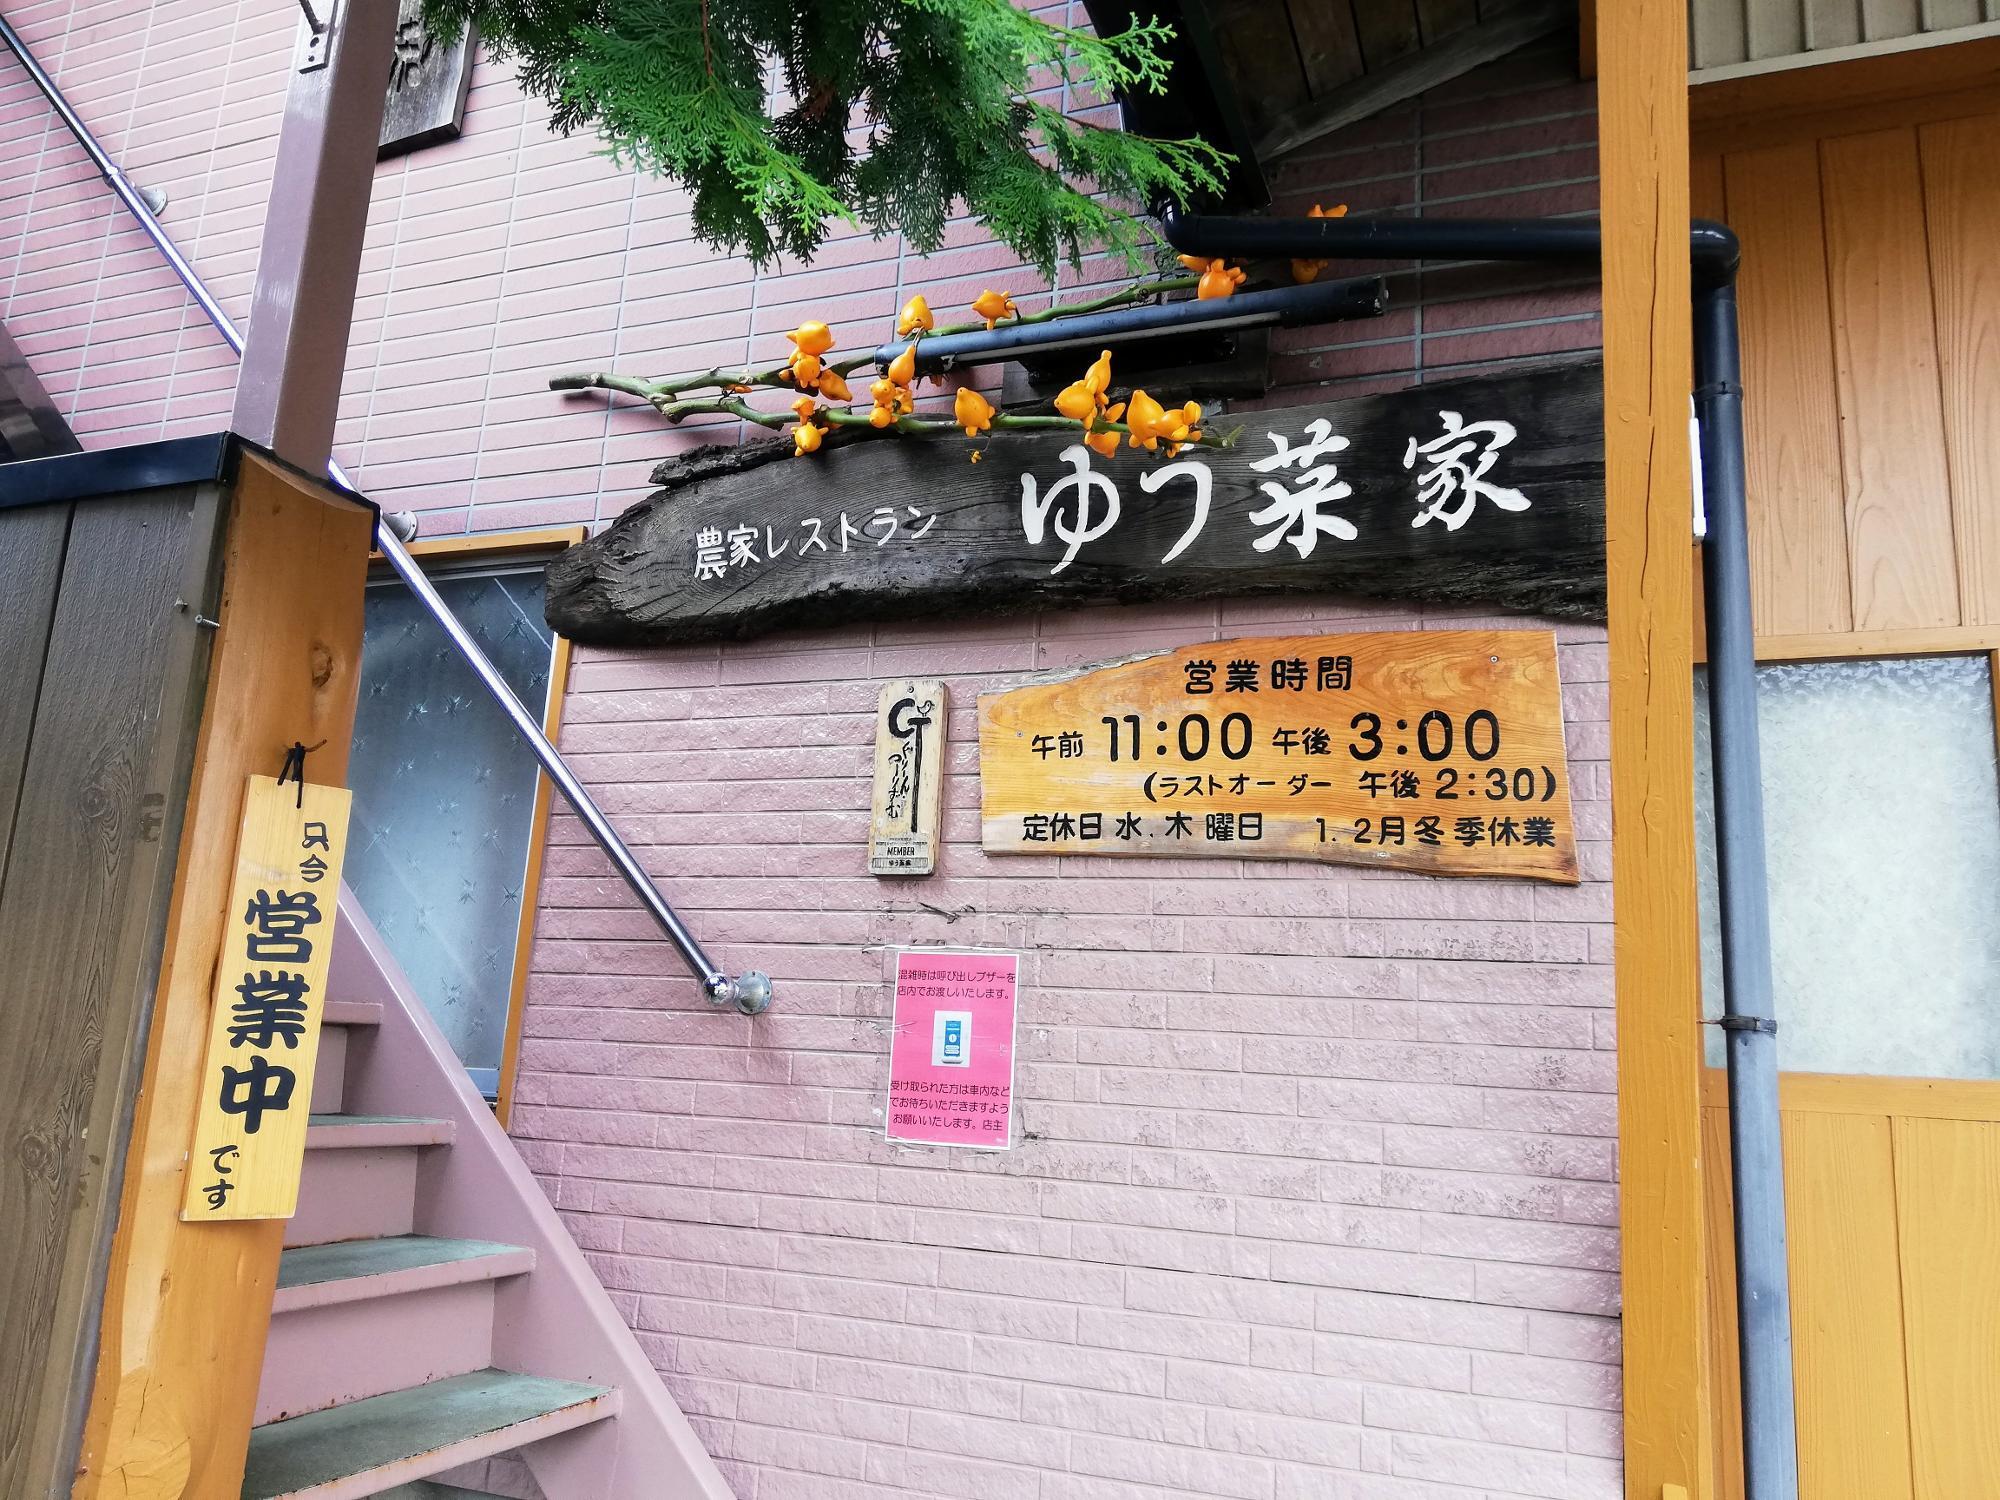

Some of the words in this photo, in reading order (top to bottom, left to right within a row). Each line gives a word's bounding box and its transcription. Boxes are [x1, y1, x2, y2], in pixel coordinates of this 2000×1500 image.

[694, 506, 936, 580] 農家レストラン
[1184, 655, 1352, 694] 営業時間
[1032, 731, 1084, 760] 午前
[1102, 712, 1252, 762] 11:00
[1272, 727, 1331, 755] 午後
[1349, 709, 1500, 761] 3:00
[1359, 770, 1420, 799] 午後
[887, 846, 915, 856] MEMBER
[897, 985, 1009, 1000] 店内でお渡しいたします。
[890, 1080, 1010, 1097] 受け取られた方は車内など
[890, 1097, 1009, 1114] でお待ちいただきますよう
